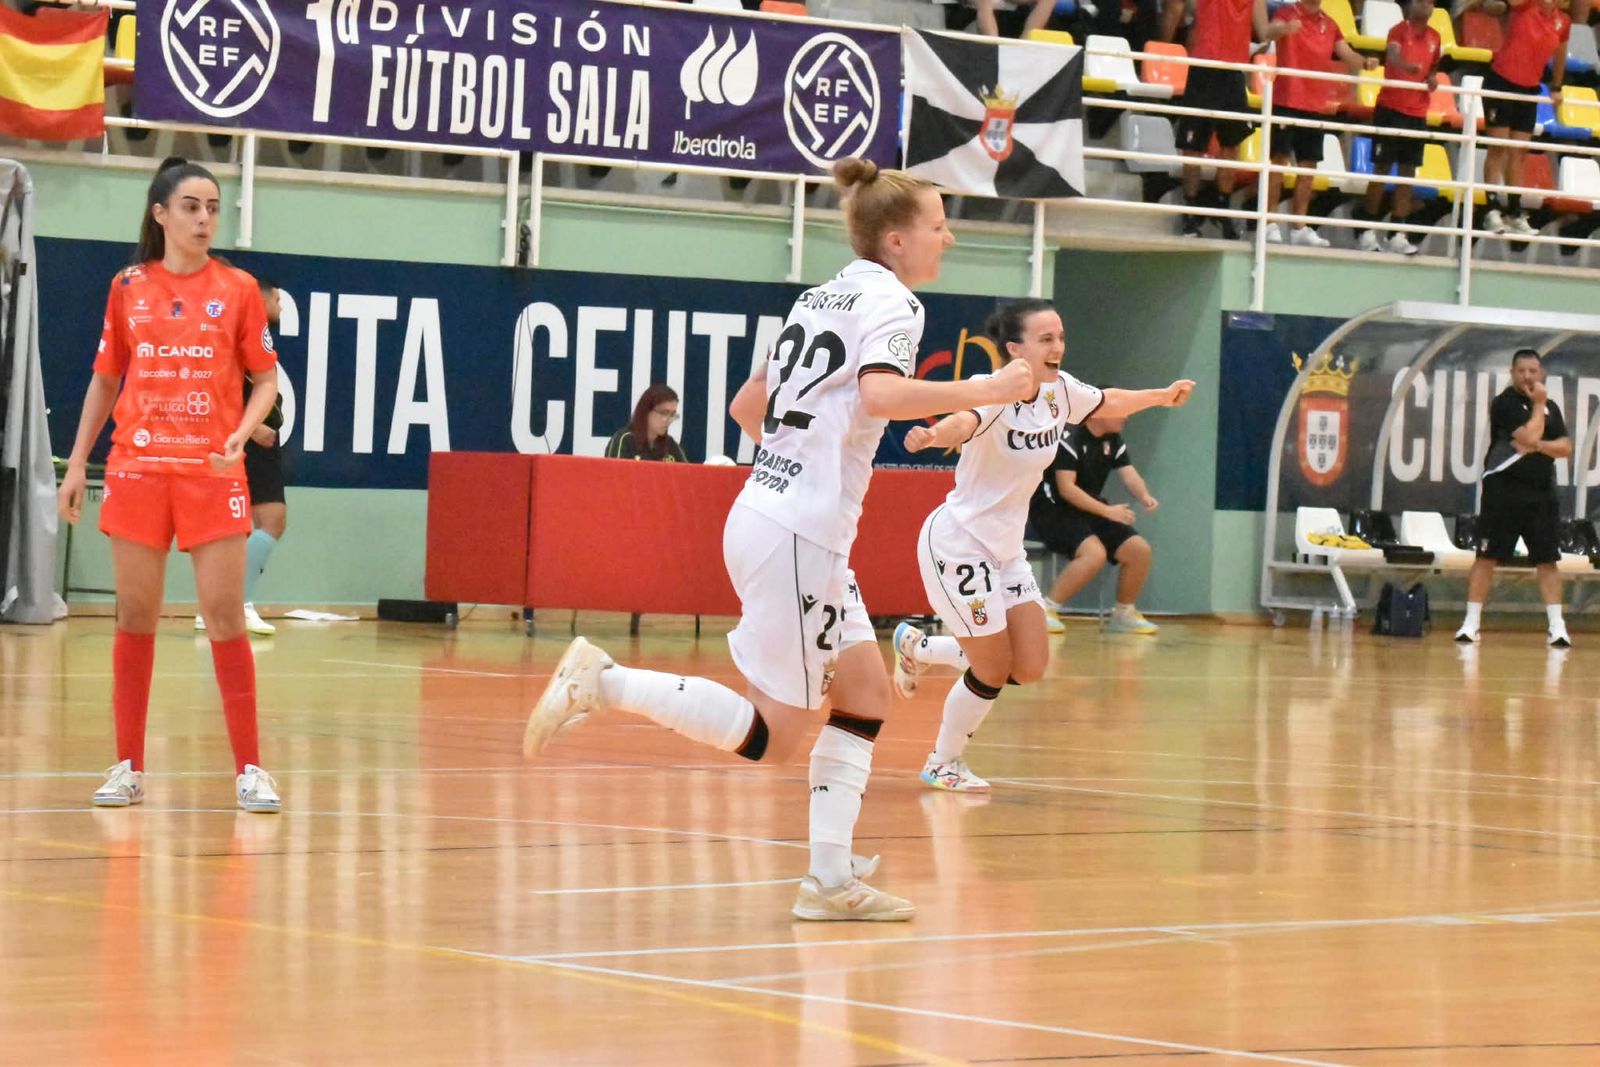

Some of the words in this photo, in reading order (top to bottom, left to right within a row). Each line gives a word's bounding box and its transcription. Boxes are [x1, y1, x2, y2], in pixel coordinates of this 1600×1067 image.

[369, 0, 650, 57] DIVISIÓN
[366, 34, 531, 139] FÚTBOL
[547, 61, 650, 150] SALA
[672, 130, 756, 159] Iberdrola
[158, 345, 213, 358] CANDO
[764, 323, 847, 434] 22
[1389, 366, 1600, 487] CIUD
[956, 561, 992, 596] 21
